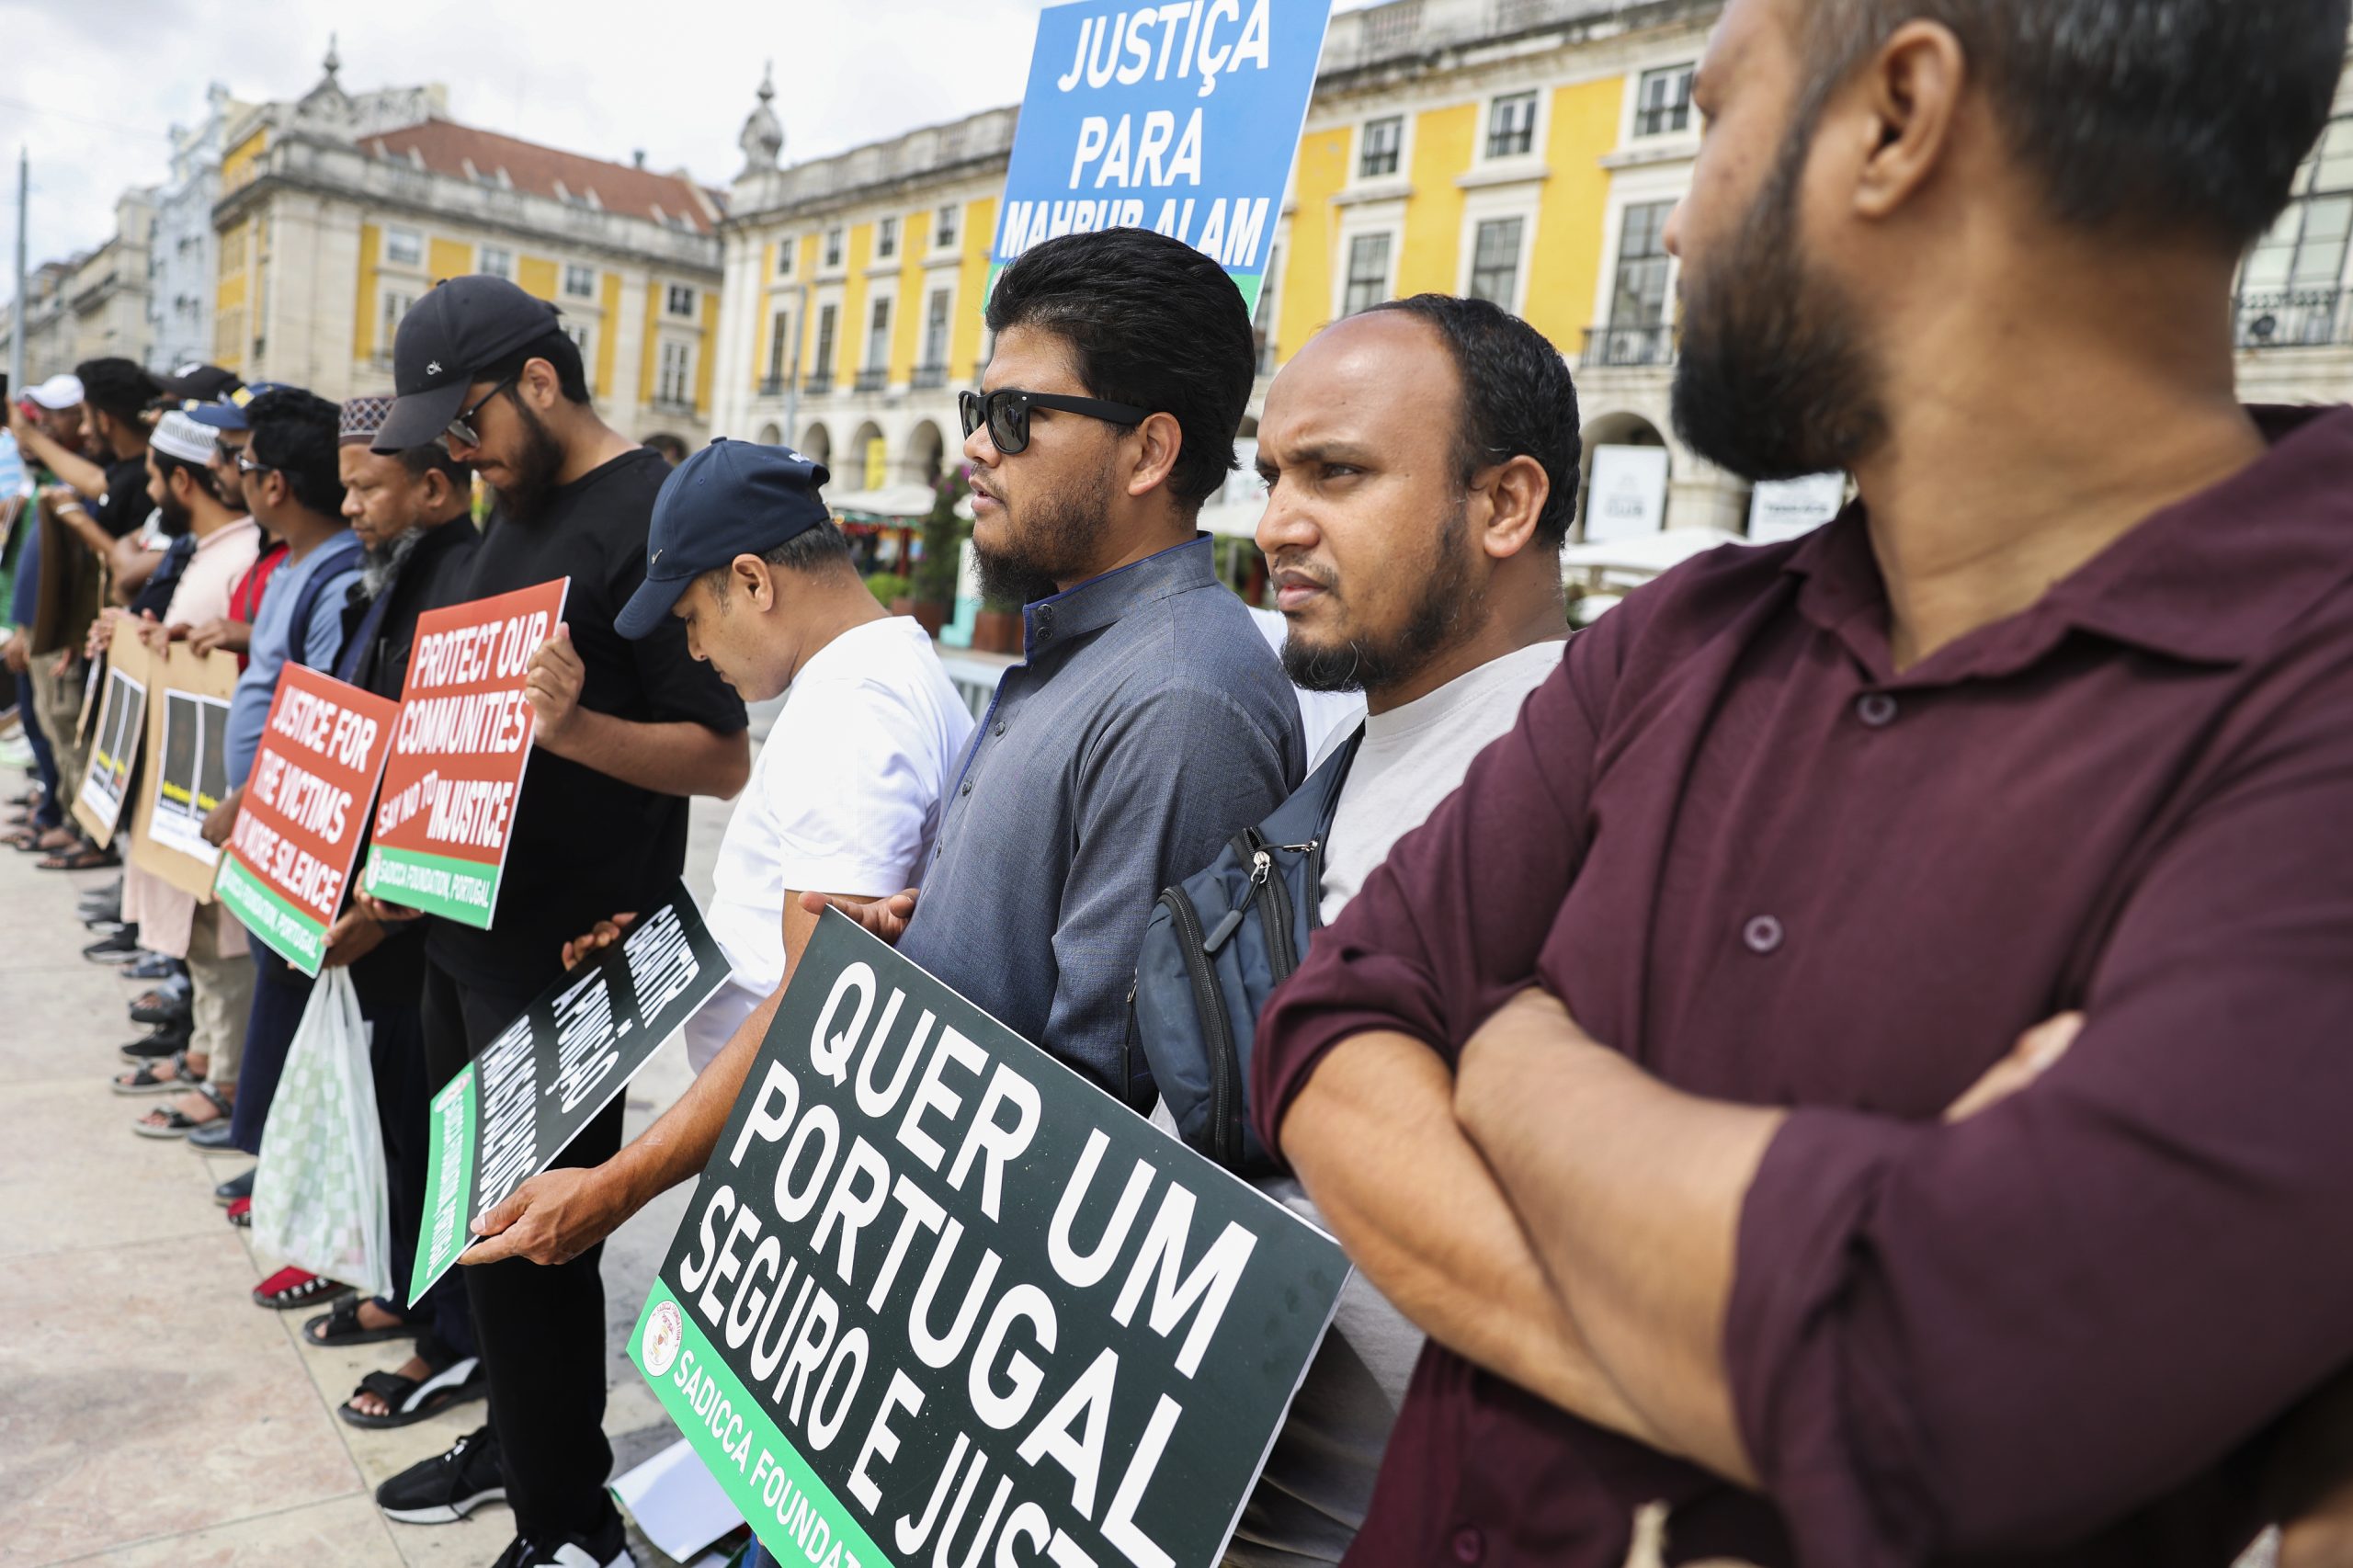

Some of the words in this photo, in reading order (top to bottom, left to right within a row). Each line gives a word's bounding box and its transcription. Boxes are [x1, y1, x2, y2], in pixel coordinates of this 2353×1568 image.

[1057, 0, 1269, 97] JUSTIÇA
[1069, 108, 1202, 188] PARA
[411, 620, 503, 689] PROTECT
[495, 610, 548, 679] OUR
[271, 684, 337, 754] JUSTICE
[326, 709, 378, 773] FOR
[396, 689, 530, 755] COMMUNITIES
[276, 761, 353, 845] VICTIMS
[426, 779, 514, 848] INJUSTICE
[269, 837, 343, 915] SILENCE
[551, 965, 602, 1018] A
[623, 903, 700, 1029] GARANTIR
[810, 961, 1042, 1223] QUER
[1047, 1127, 1258, 1380] UM
[679, 1185, 870, 1451] SEGURO
[846, 1367, 926, 1516] E
[729, 1059, 1183, 1568] PORTUGAL
[673, 1349, 753, 1474] SADICCA
